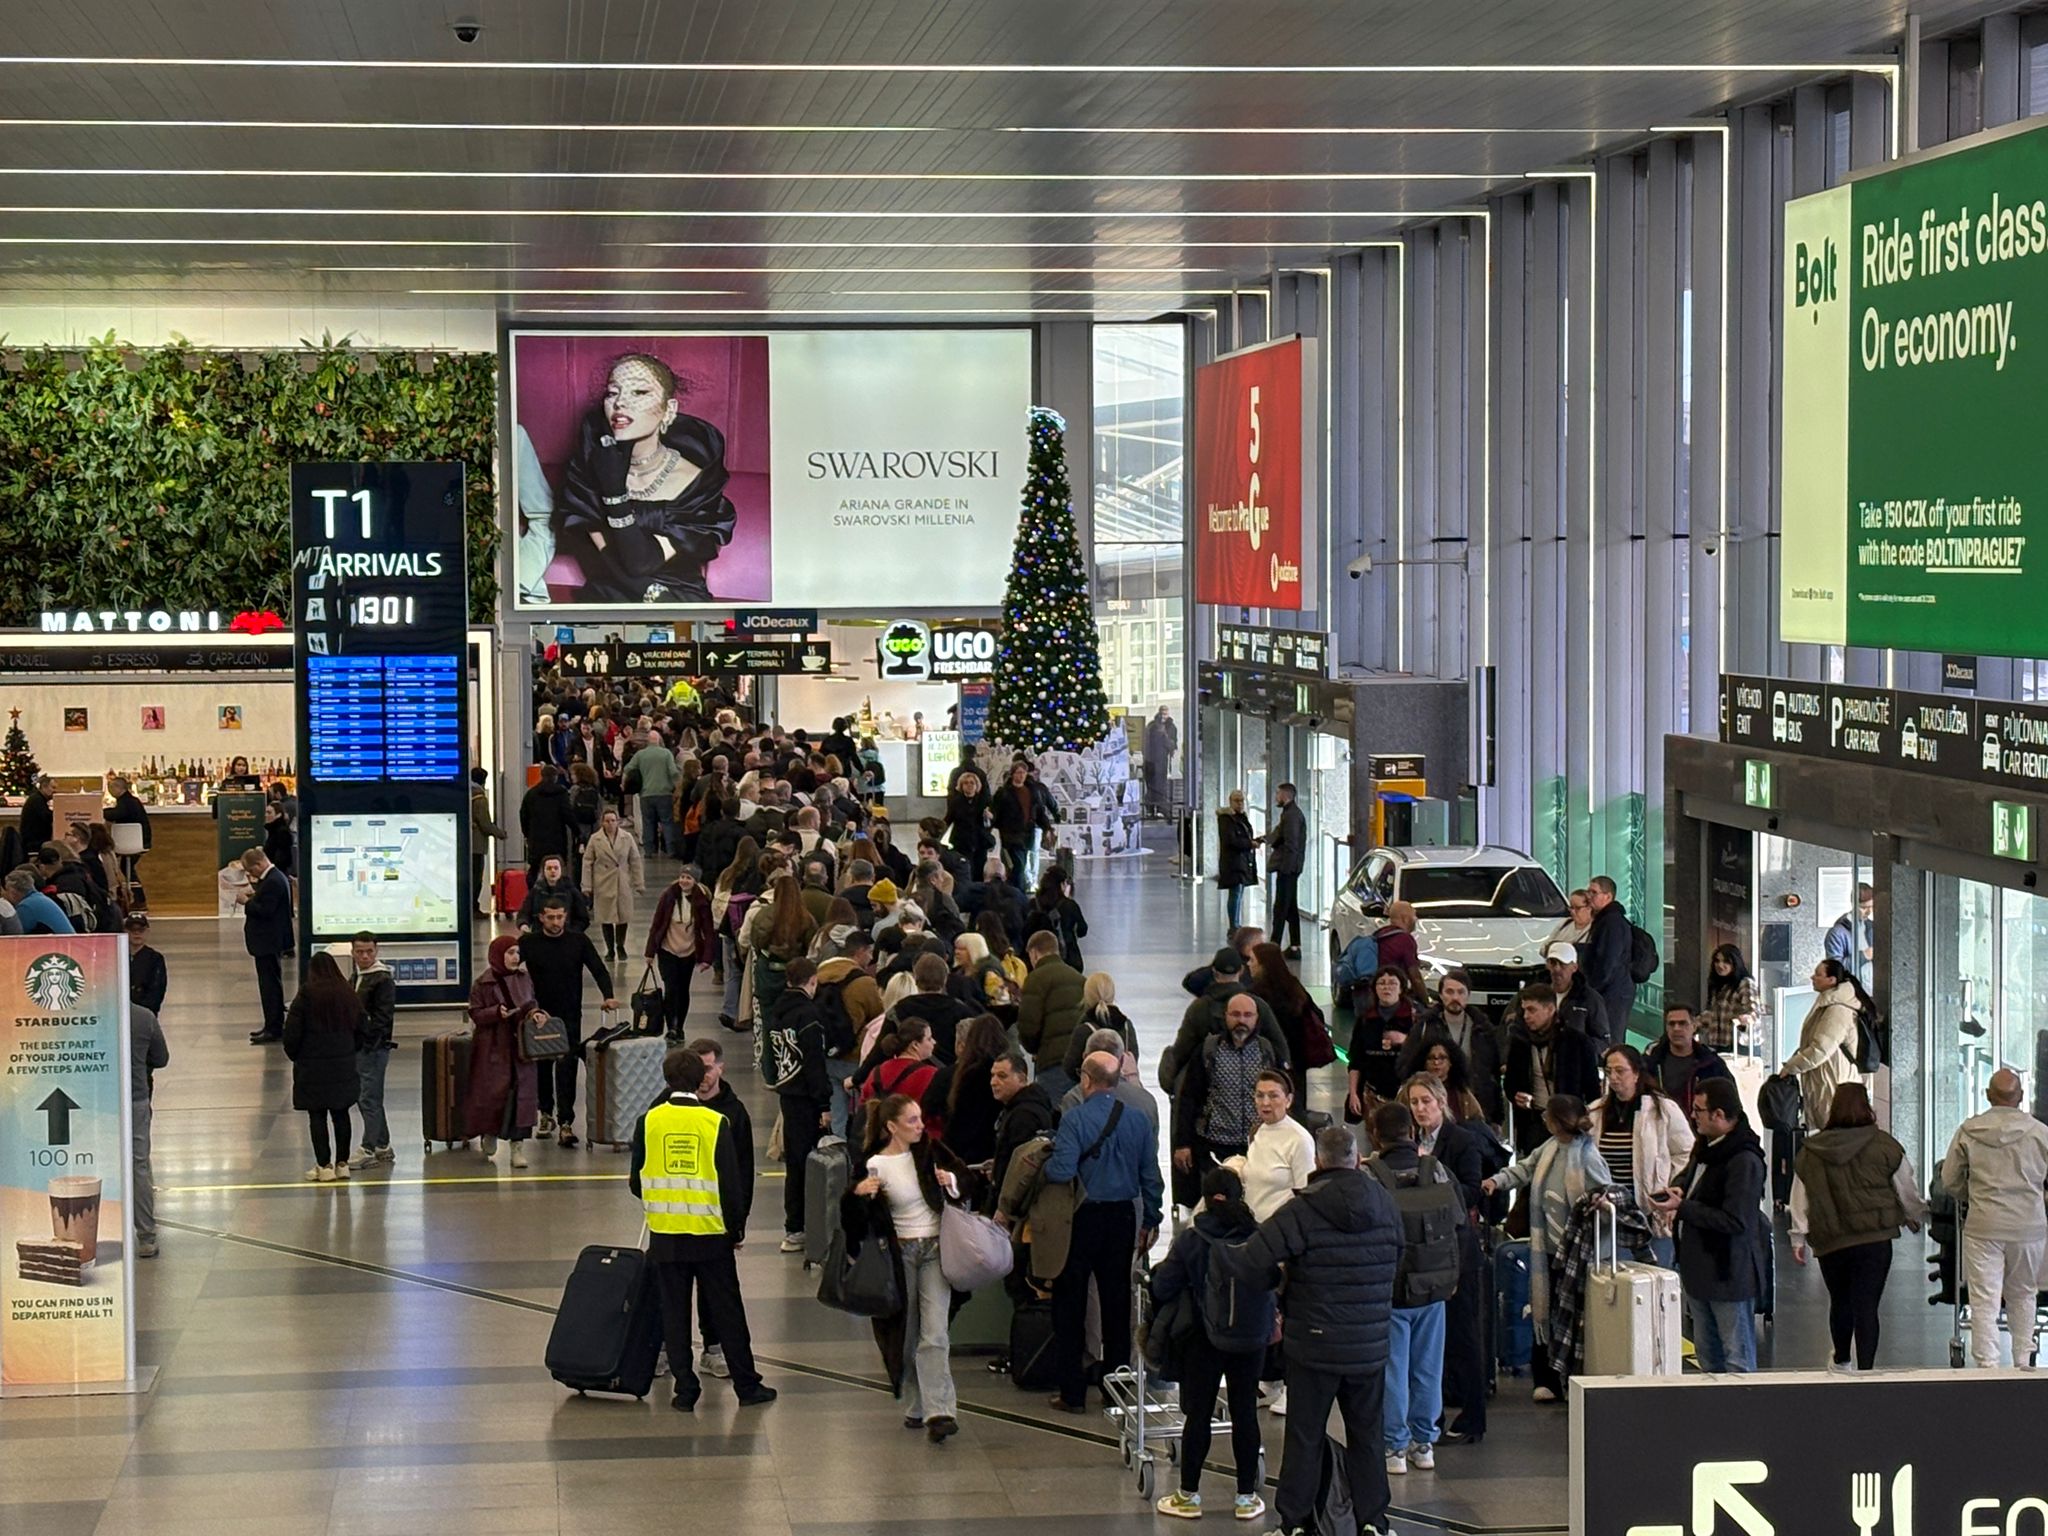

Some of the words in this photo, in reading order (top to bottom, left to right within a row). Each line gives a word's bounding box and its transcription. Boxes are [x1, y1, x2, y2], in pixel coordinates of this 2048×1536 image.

[1862, 217, 1914, 289] Ride
[1919, 206, 1970, 277] first
[1795, 235, 1837, 325] Bolt
[1861, 306, 1890, 372] Or
[1894, 301, 2017, 372] economy.
[1249, 385, 1261, 465] 5
[807, 450, 1000, 479] SWAROVSKI
[311, 489, 372, 540] T1
[839, 499, 891, 511] ARIANA
[894, 499, 951, 510] GRANDE
[955, 498, 969, 510] IN
[1858, 501, 1883, 530] Take
[1884, 500, 1903, 529] 150
[1904, 499, 1928, 528] CZK
[1928, 497, 1945, 528] off
[1945, 503, 1972, 535] your
[1972, 496, 1997, 527] first
[1998, 495, 2022, 527] ride
[833, 515, 910, 527] SWAROVSKI
[914, 514, 976, 526] MILLENIA
[318, 551, 443, 578] ARRIVALS
[1858, 537, 1880, 567] with
[1880, 538, 1898, 567] the
[1899, 538, 1925, 567] code
[40, 610, 220, 632] MATTONI
[742, 615, 810, 629] JCDecaux
[933, 630, 996, 660] UGO
[107, 652, 159, 668] ESPRESSO
[209, 651, 270, 667] CAPPUCCINO
[1736, 682, 1763, 710] VÝCHOD
[1787, 692, 1820, 717] AUTOBUS
[1736, 712, 1752, 736] EXIT
[1787, 719, 1803, 744] BUS
[1919, 703, 1969, 736] TAXISLUŽBA
[1843, 727, 1860, 751] CAR
[1859, 729, 1881, 754] PARK
[1919, 736, 1938, 763] TAXI
[2002, 748, 2022, 776] CAR
[15, 1015, 99, 1028] STARBUCKS
[9, 1053, 25, 1063] OF
[25, 1053, 55, 1063] YOUR
[57, 1051, 107, 1062] JOURNEY
[19, 1041, 40, 1051] THE
[41, 1040, 67, 1050] BEST
[68, 1039, 96, 1050] PART
[7, 1066, 15, 1075] A
[16, 1065, 39, 1075] FEW
[41, 1064, 72, 1074] STEPS
[73, 1063, 110, 1073] AWAY!
[29, 1148, 68, 1167] 100
[75, 1151, 94, 1166] m
[11, 1299, 34, 1309] YOU
[35, 1298, 58, 1308] CAN
[59, 1298, 85, 1308] FIND
[86, 1296, 101, 1306] US
[102, 1296, 114, 1306] IN
[11, 1310, 73, 1321] DEPARTURE
[74, 1309, 101, 1319] HALL
[102, 1308, 114, 1318] T1
